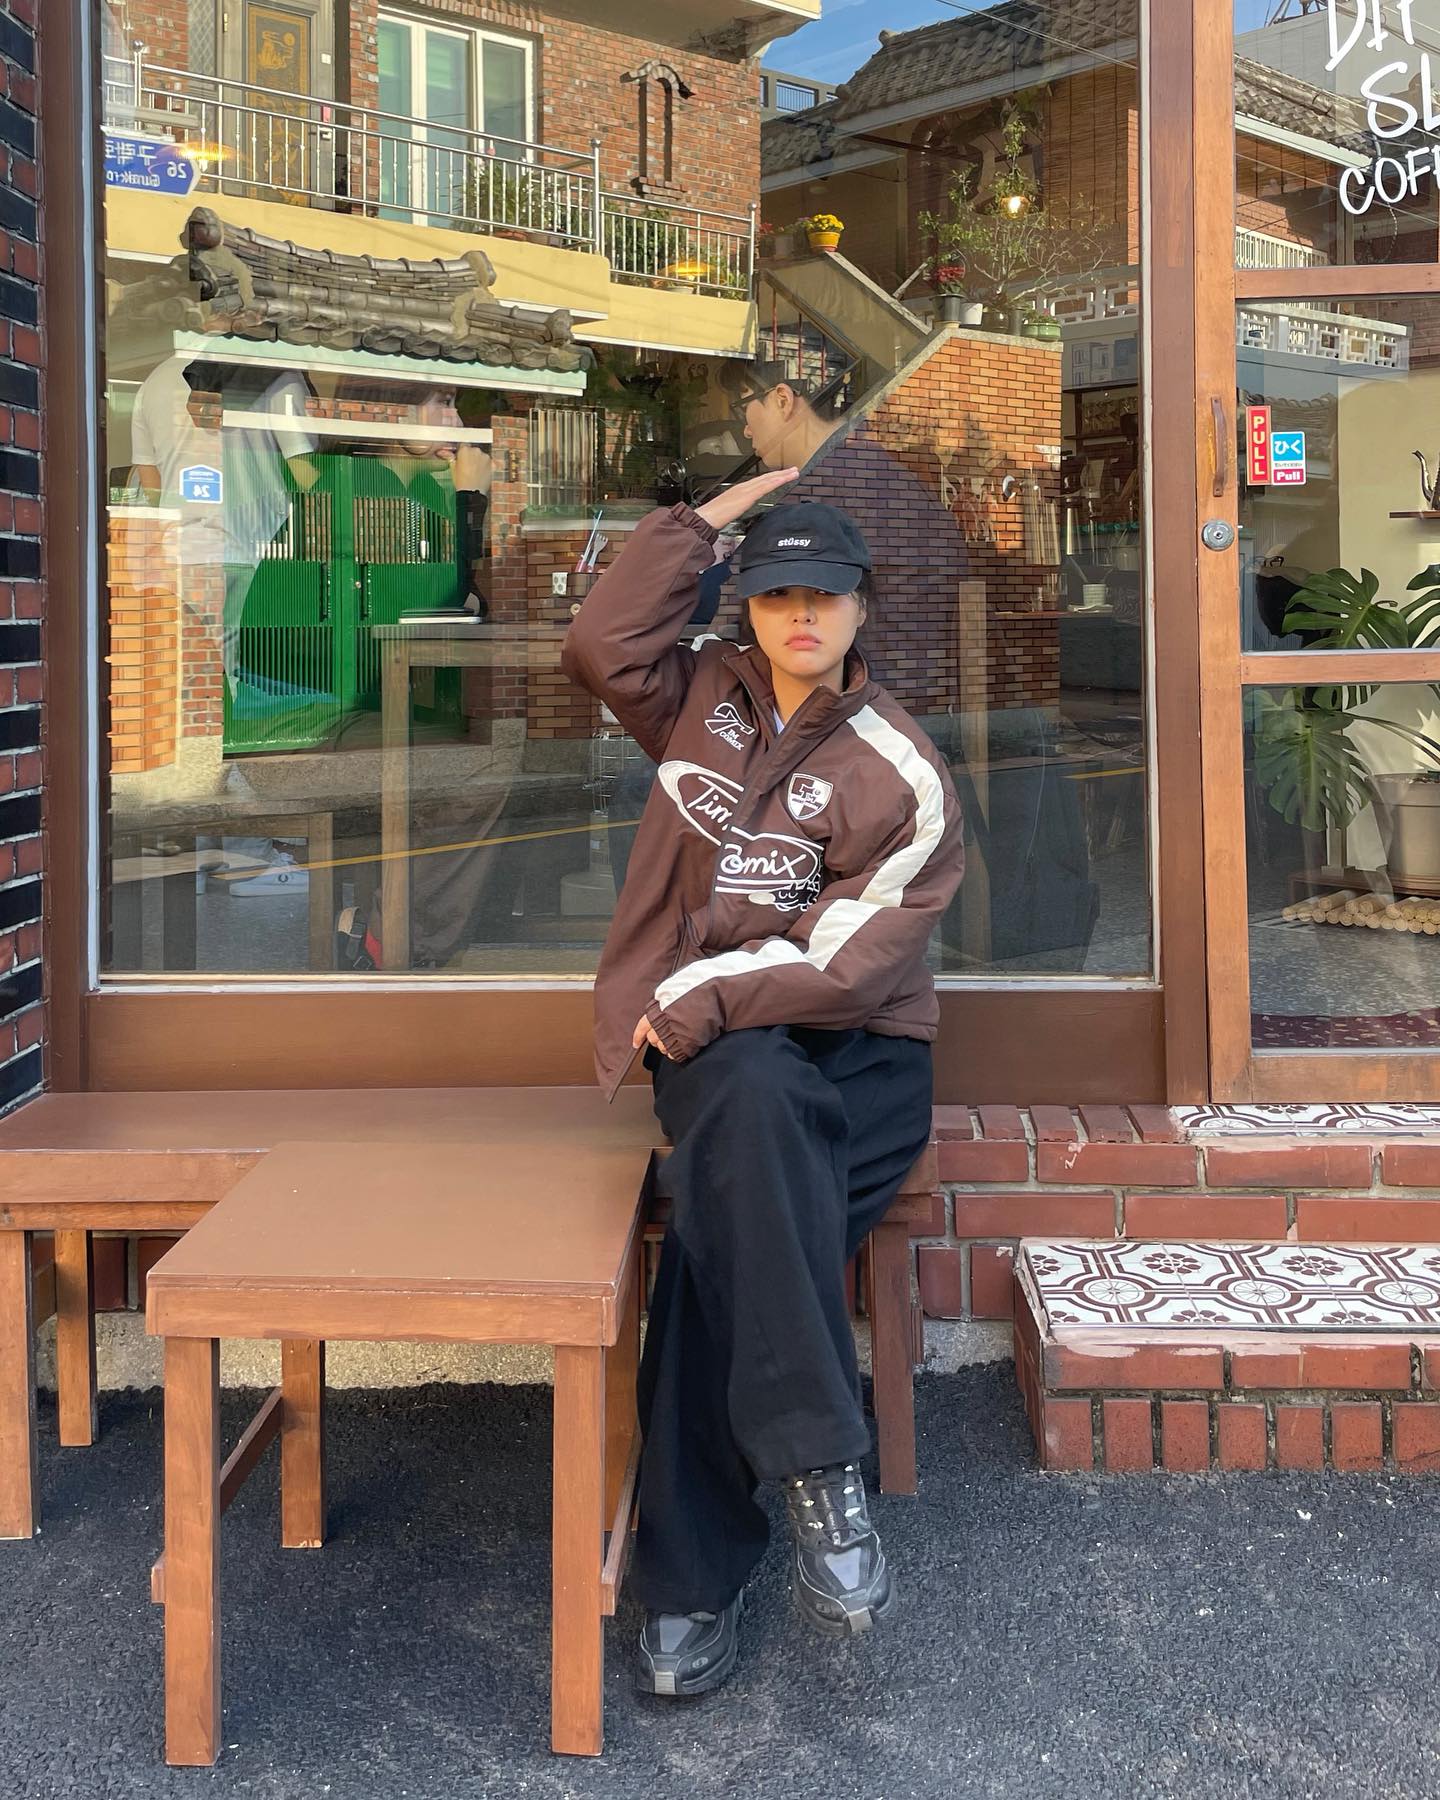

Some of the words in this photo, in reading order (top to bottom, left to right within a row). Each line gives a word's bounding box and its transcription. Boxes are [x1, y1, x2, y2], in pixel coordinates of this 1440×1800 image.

[1253, 415, 1265, 476] PULL
[1274, 440, 1301, 455] ひく
[1276, 471, 1301, 481] Pull
